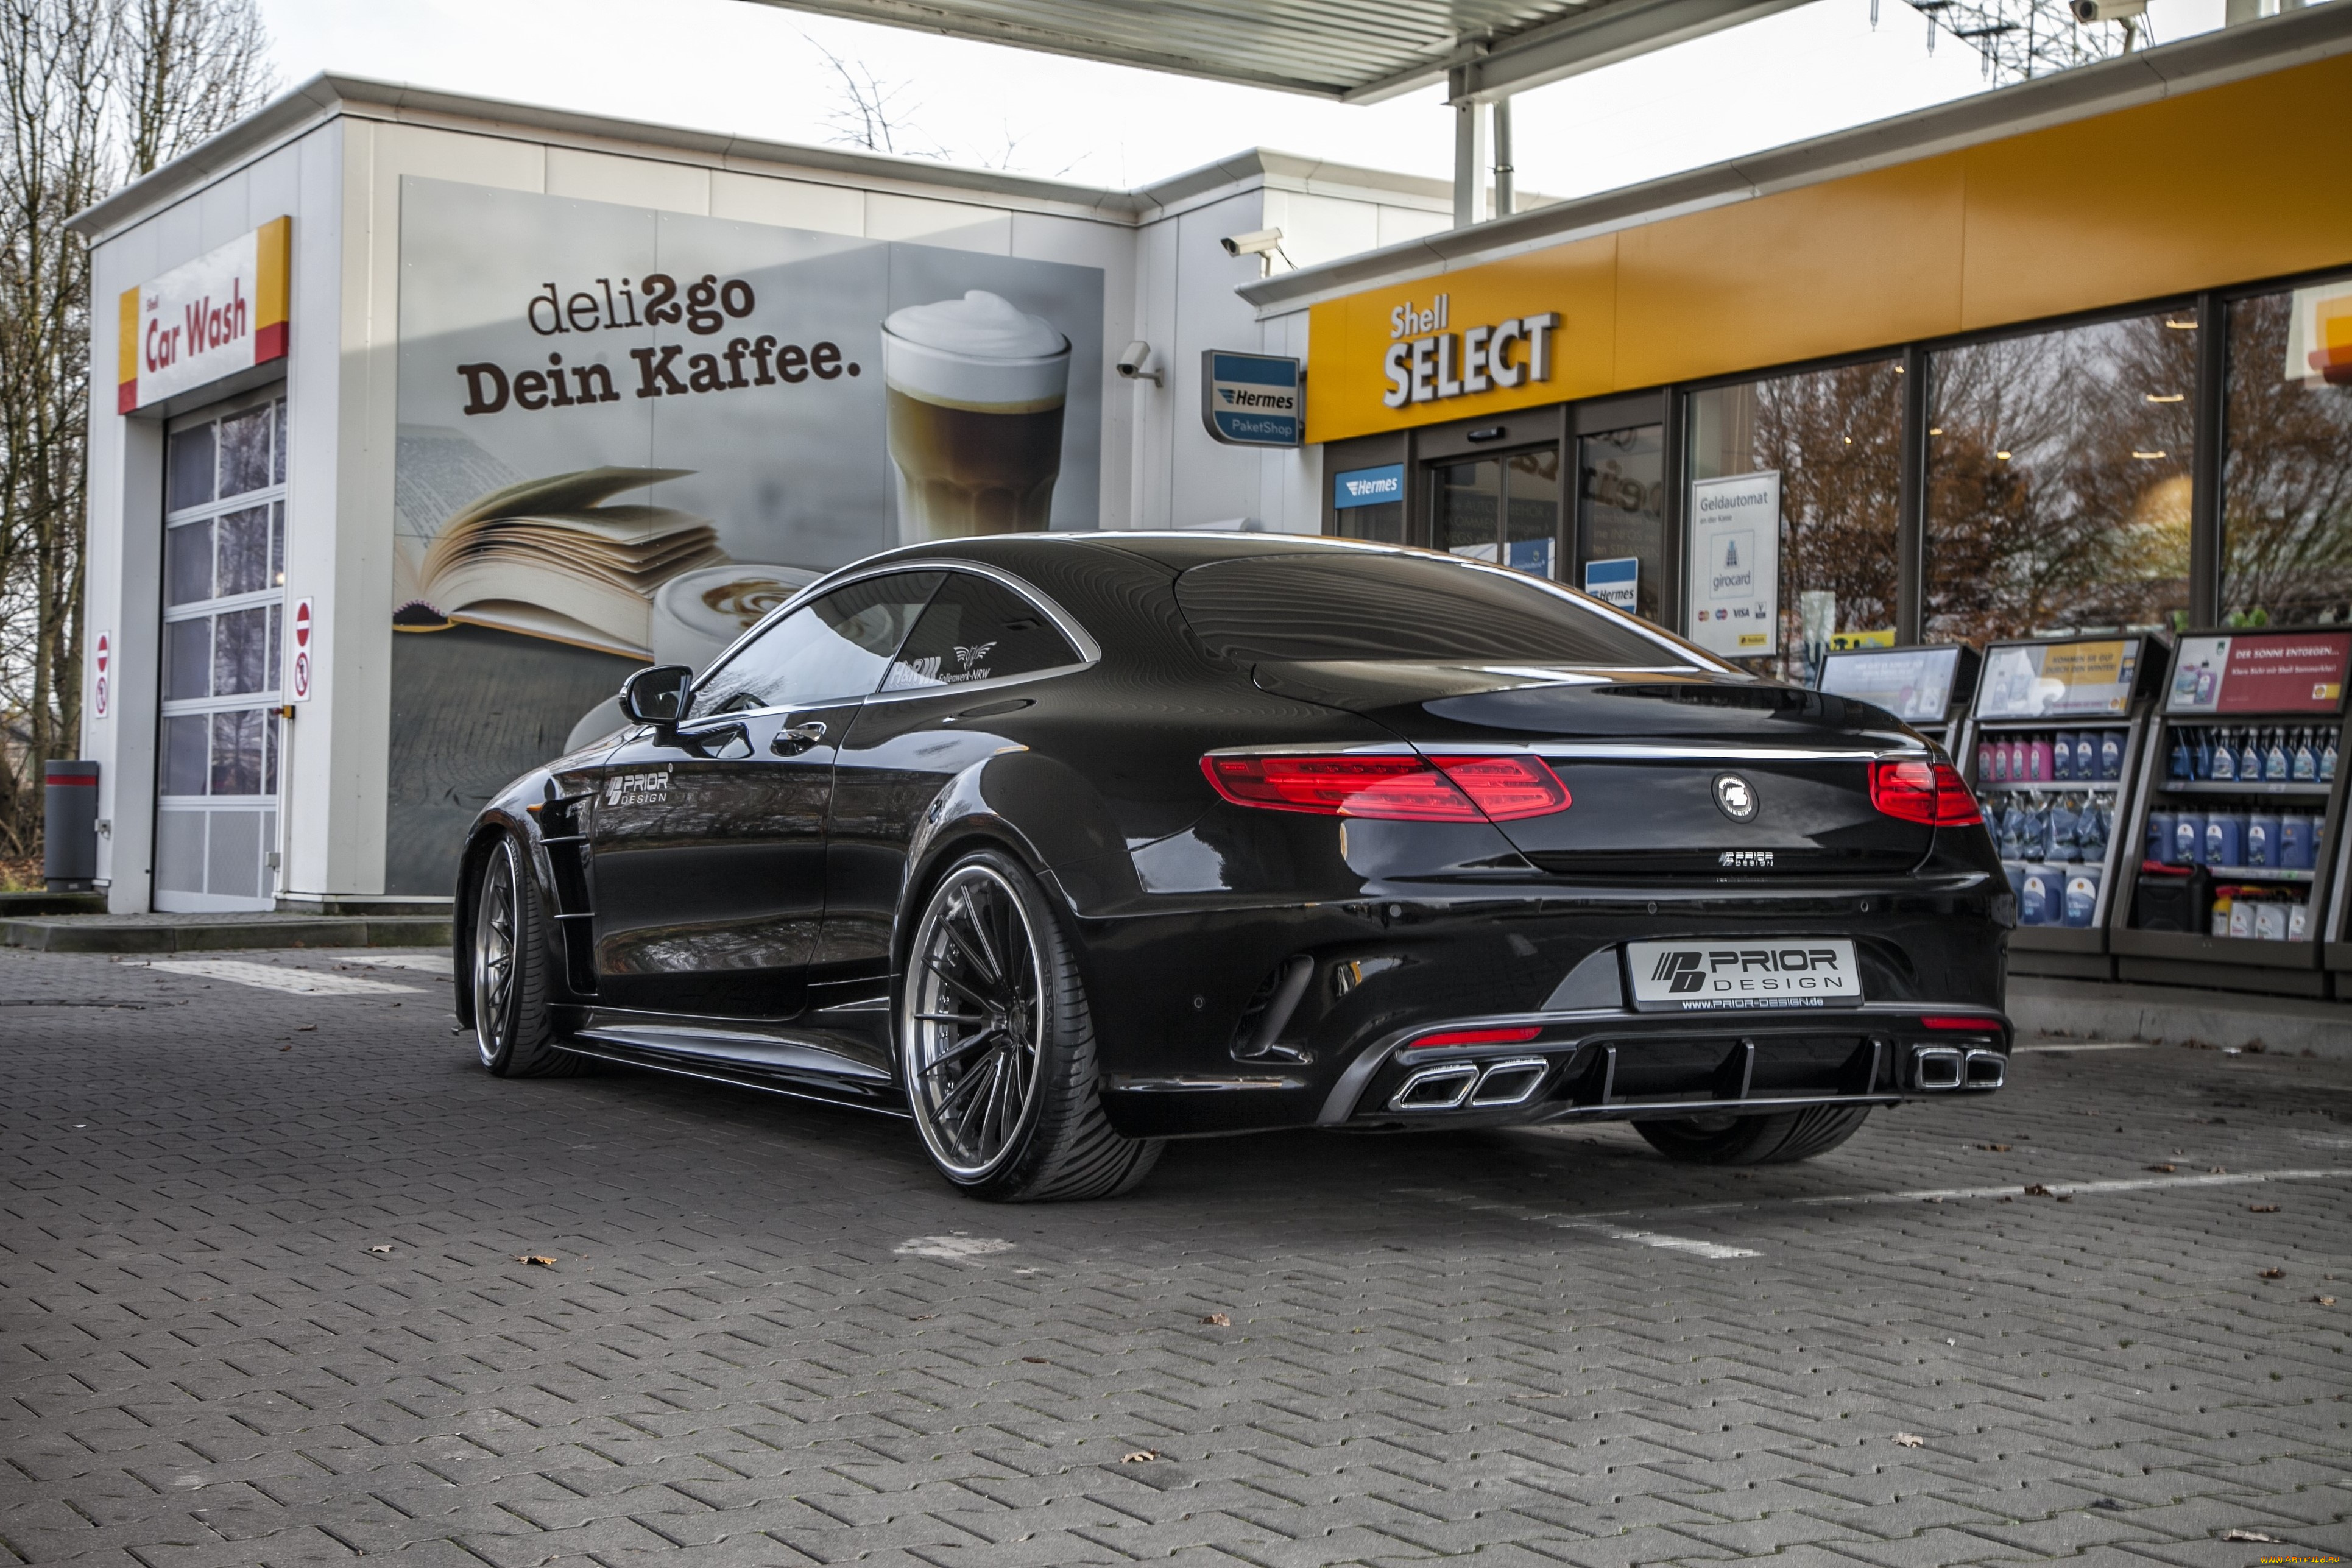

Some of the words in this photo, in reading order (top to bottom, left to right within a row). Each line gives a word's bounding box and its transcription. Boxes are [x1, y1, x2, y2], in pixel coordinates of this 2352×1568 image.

[528, 274, 755, 336] deli2go
[146, 317, 181, 373] Car
[185, 277, 246, 357] Wash
[1391, 292, 1449, 339] Shell
[1382, 312, 1559, 409] SELECT
[457, 351, 620, 415] Dein
[630, 335, 861, 398] Kaffee.
[1235, 390, 1294, 409] Hermes
[1232, 419, 1292, 437] PaketShop
[1358, 478, 1397, 495] Hermes
[1700, 491, 1768, 512] Geldautomat
[1713, 570, 1751, 592] girocard
[1600, 589, 1634, 601] Hermes
[1733, 607, 1750, 618] VISA
[2236, 649, 2251, 659] DER
[2253, 648, 2284, 658] SONNE
[623, 772, 668, 792] PRIOR
[621, 793, 667, 805] DESIGN
[1709, 949, 1839, 973] PRIOR
[1714, 977, 1843, 991] DESIGN
